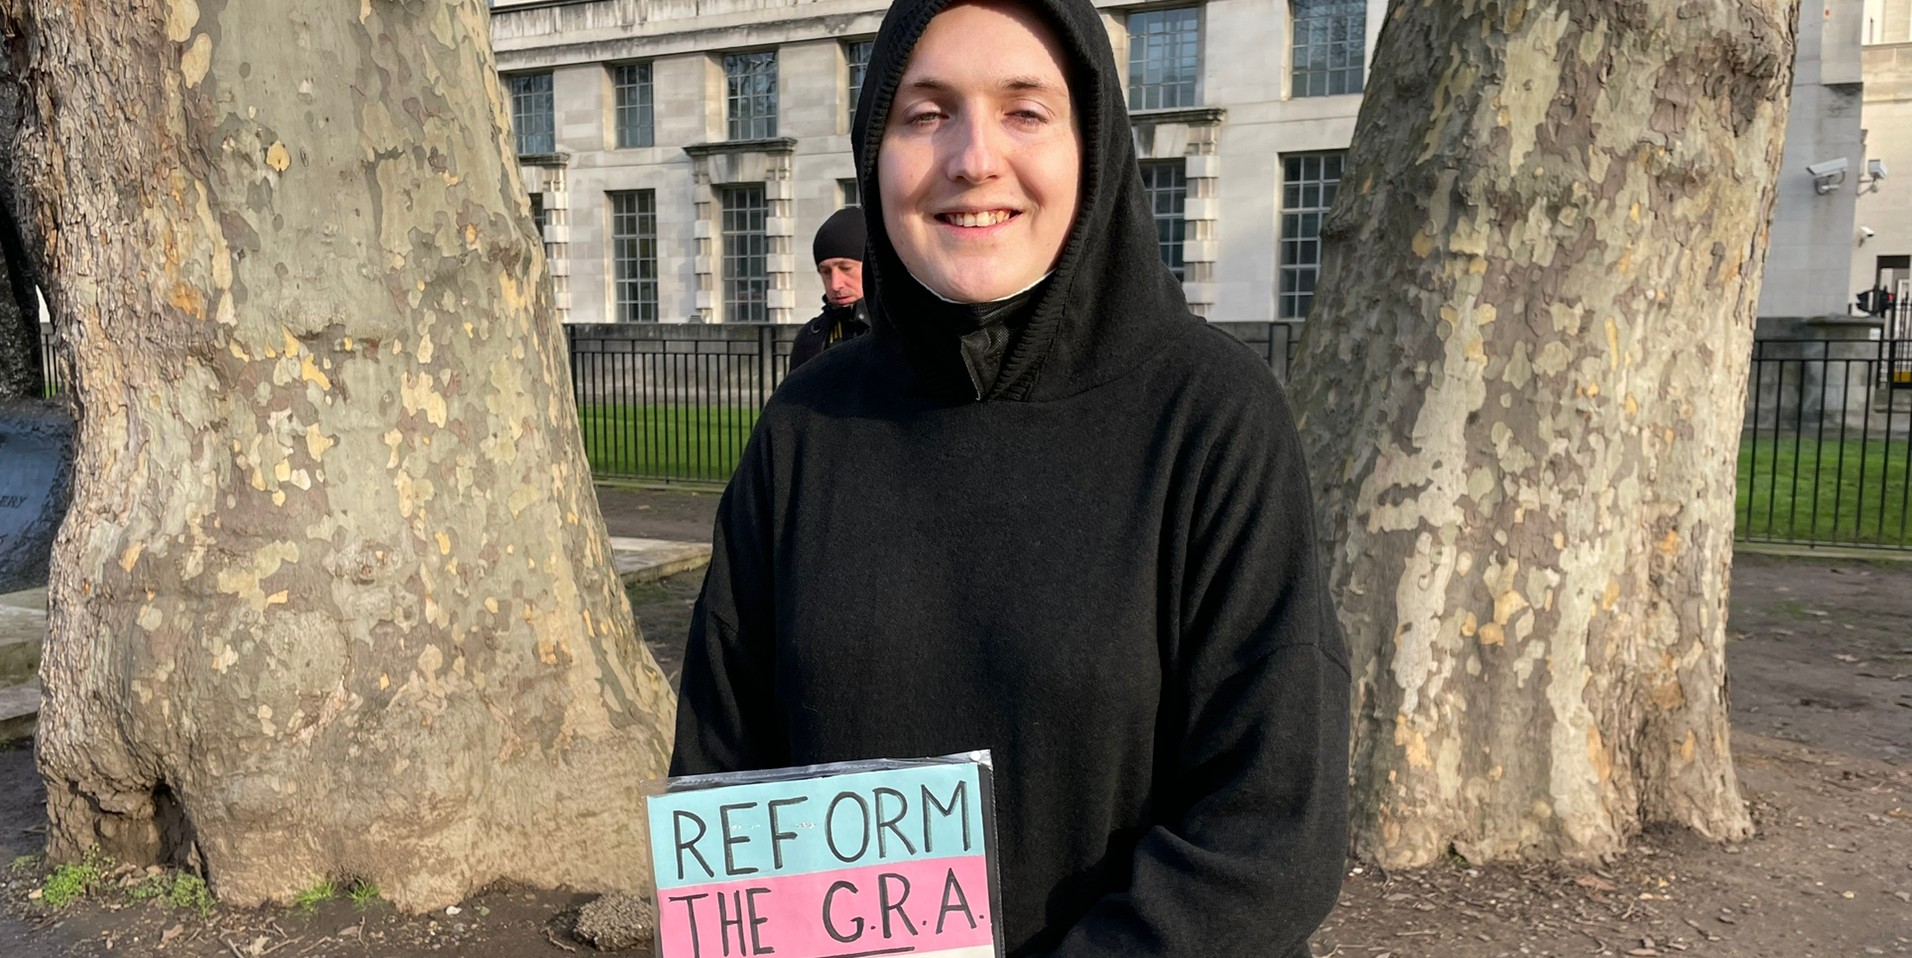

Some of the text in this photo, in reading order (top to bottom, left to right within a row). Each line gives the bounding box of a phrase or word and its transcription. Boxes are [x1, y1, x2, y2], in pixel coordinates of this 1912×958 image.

[673, 780, 972, 880] REFORM
[668, 868, 984, 958] THE G.R.A.
